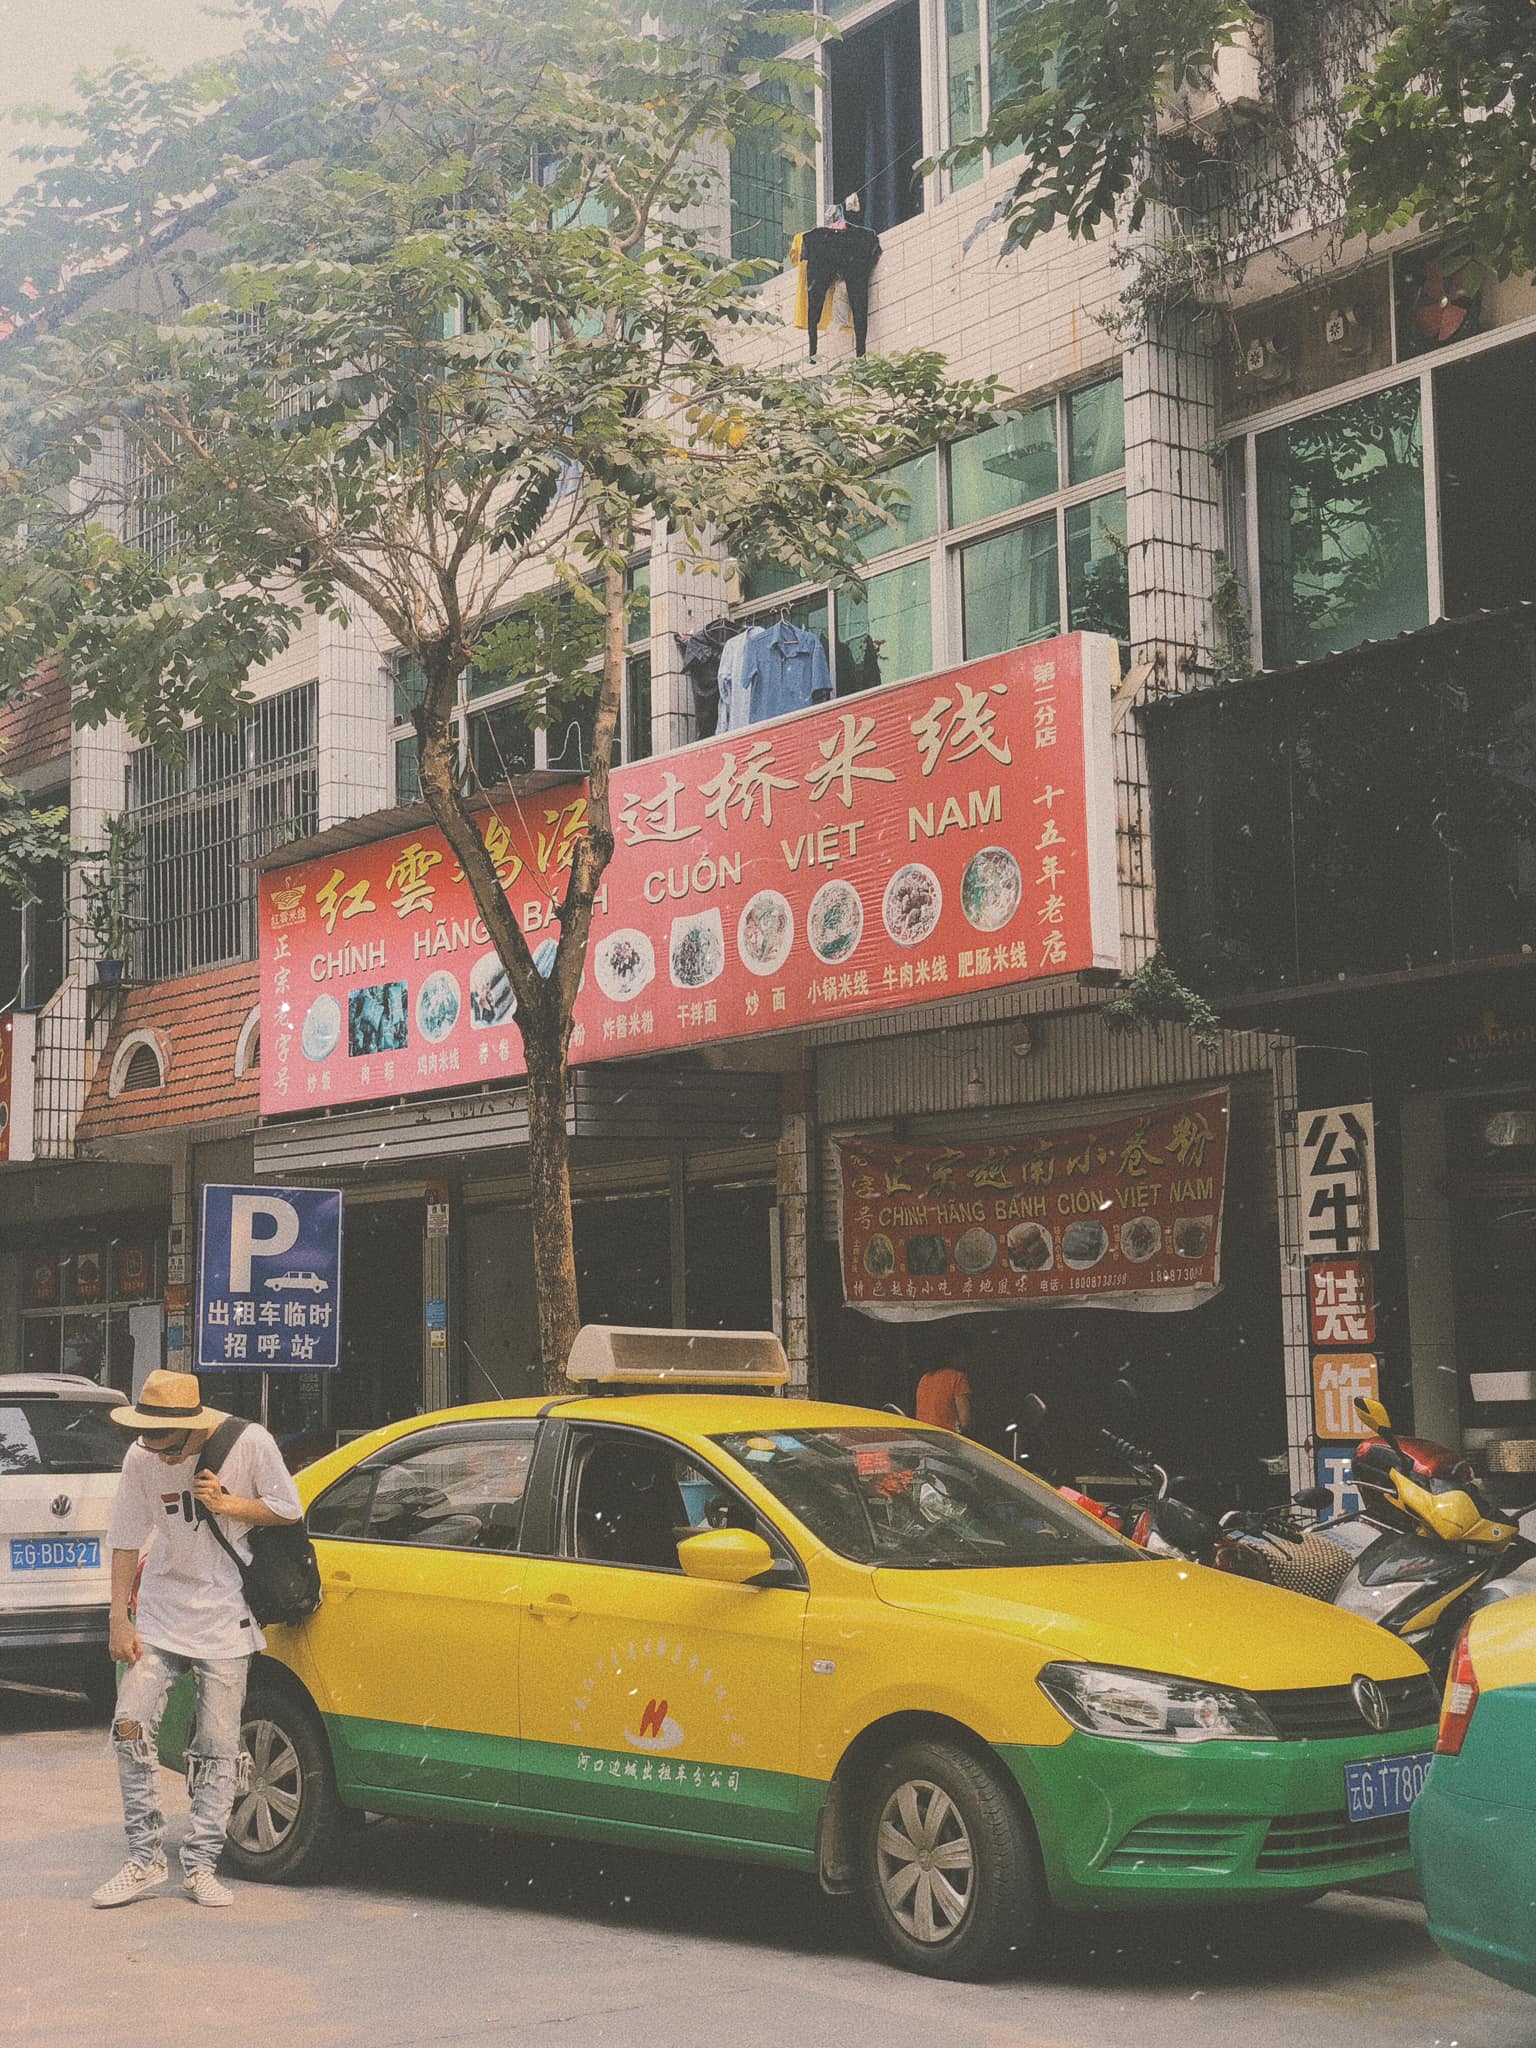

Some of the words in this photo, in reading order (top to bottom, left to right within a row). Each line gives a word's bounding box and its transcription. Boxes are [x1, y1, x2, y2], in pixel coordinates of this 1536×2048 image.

[1032, 662, 1057, 749] 第二分店
[618, 682, 1013, 847] 过桥米线
[310, 939, 386, 982] CHÍNH
[413, 914, 490, 960] HÃNG
[523, 883, 608, 933] BÁH
[780, 820, 865, 872] VIỆT
[908, 785, 1003, 842] NAM
[1032, 784, 1067, 969] 十五年老店
[882, 954, 948, 991] 牛肉米线
[958, 941, 1027, 978] 肥肠米线
[745, 986, 786, 1016] 炒面
[807, 970, 869, 1004] 小锅米线
[677, 999, 717, 1029] 干拌面
[1169, 1177, 1213, 1203] NAM
[1303, 1111, 1368, 1251] 公牛
[229, 1194, 300, 1293] P
[207, 1299, 332, 1328] 出租车临时
[224, 1332, 314, 1360] 招呼站
[577, 1751, 740, 1792] 河口边城出租车分公司
